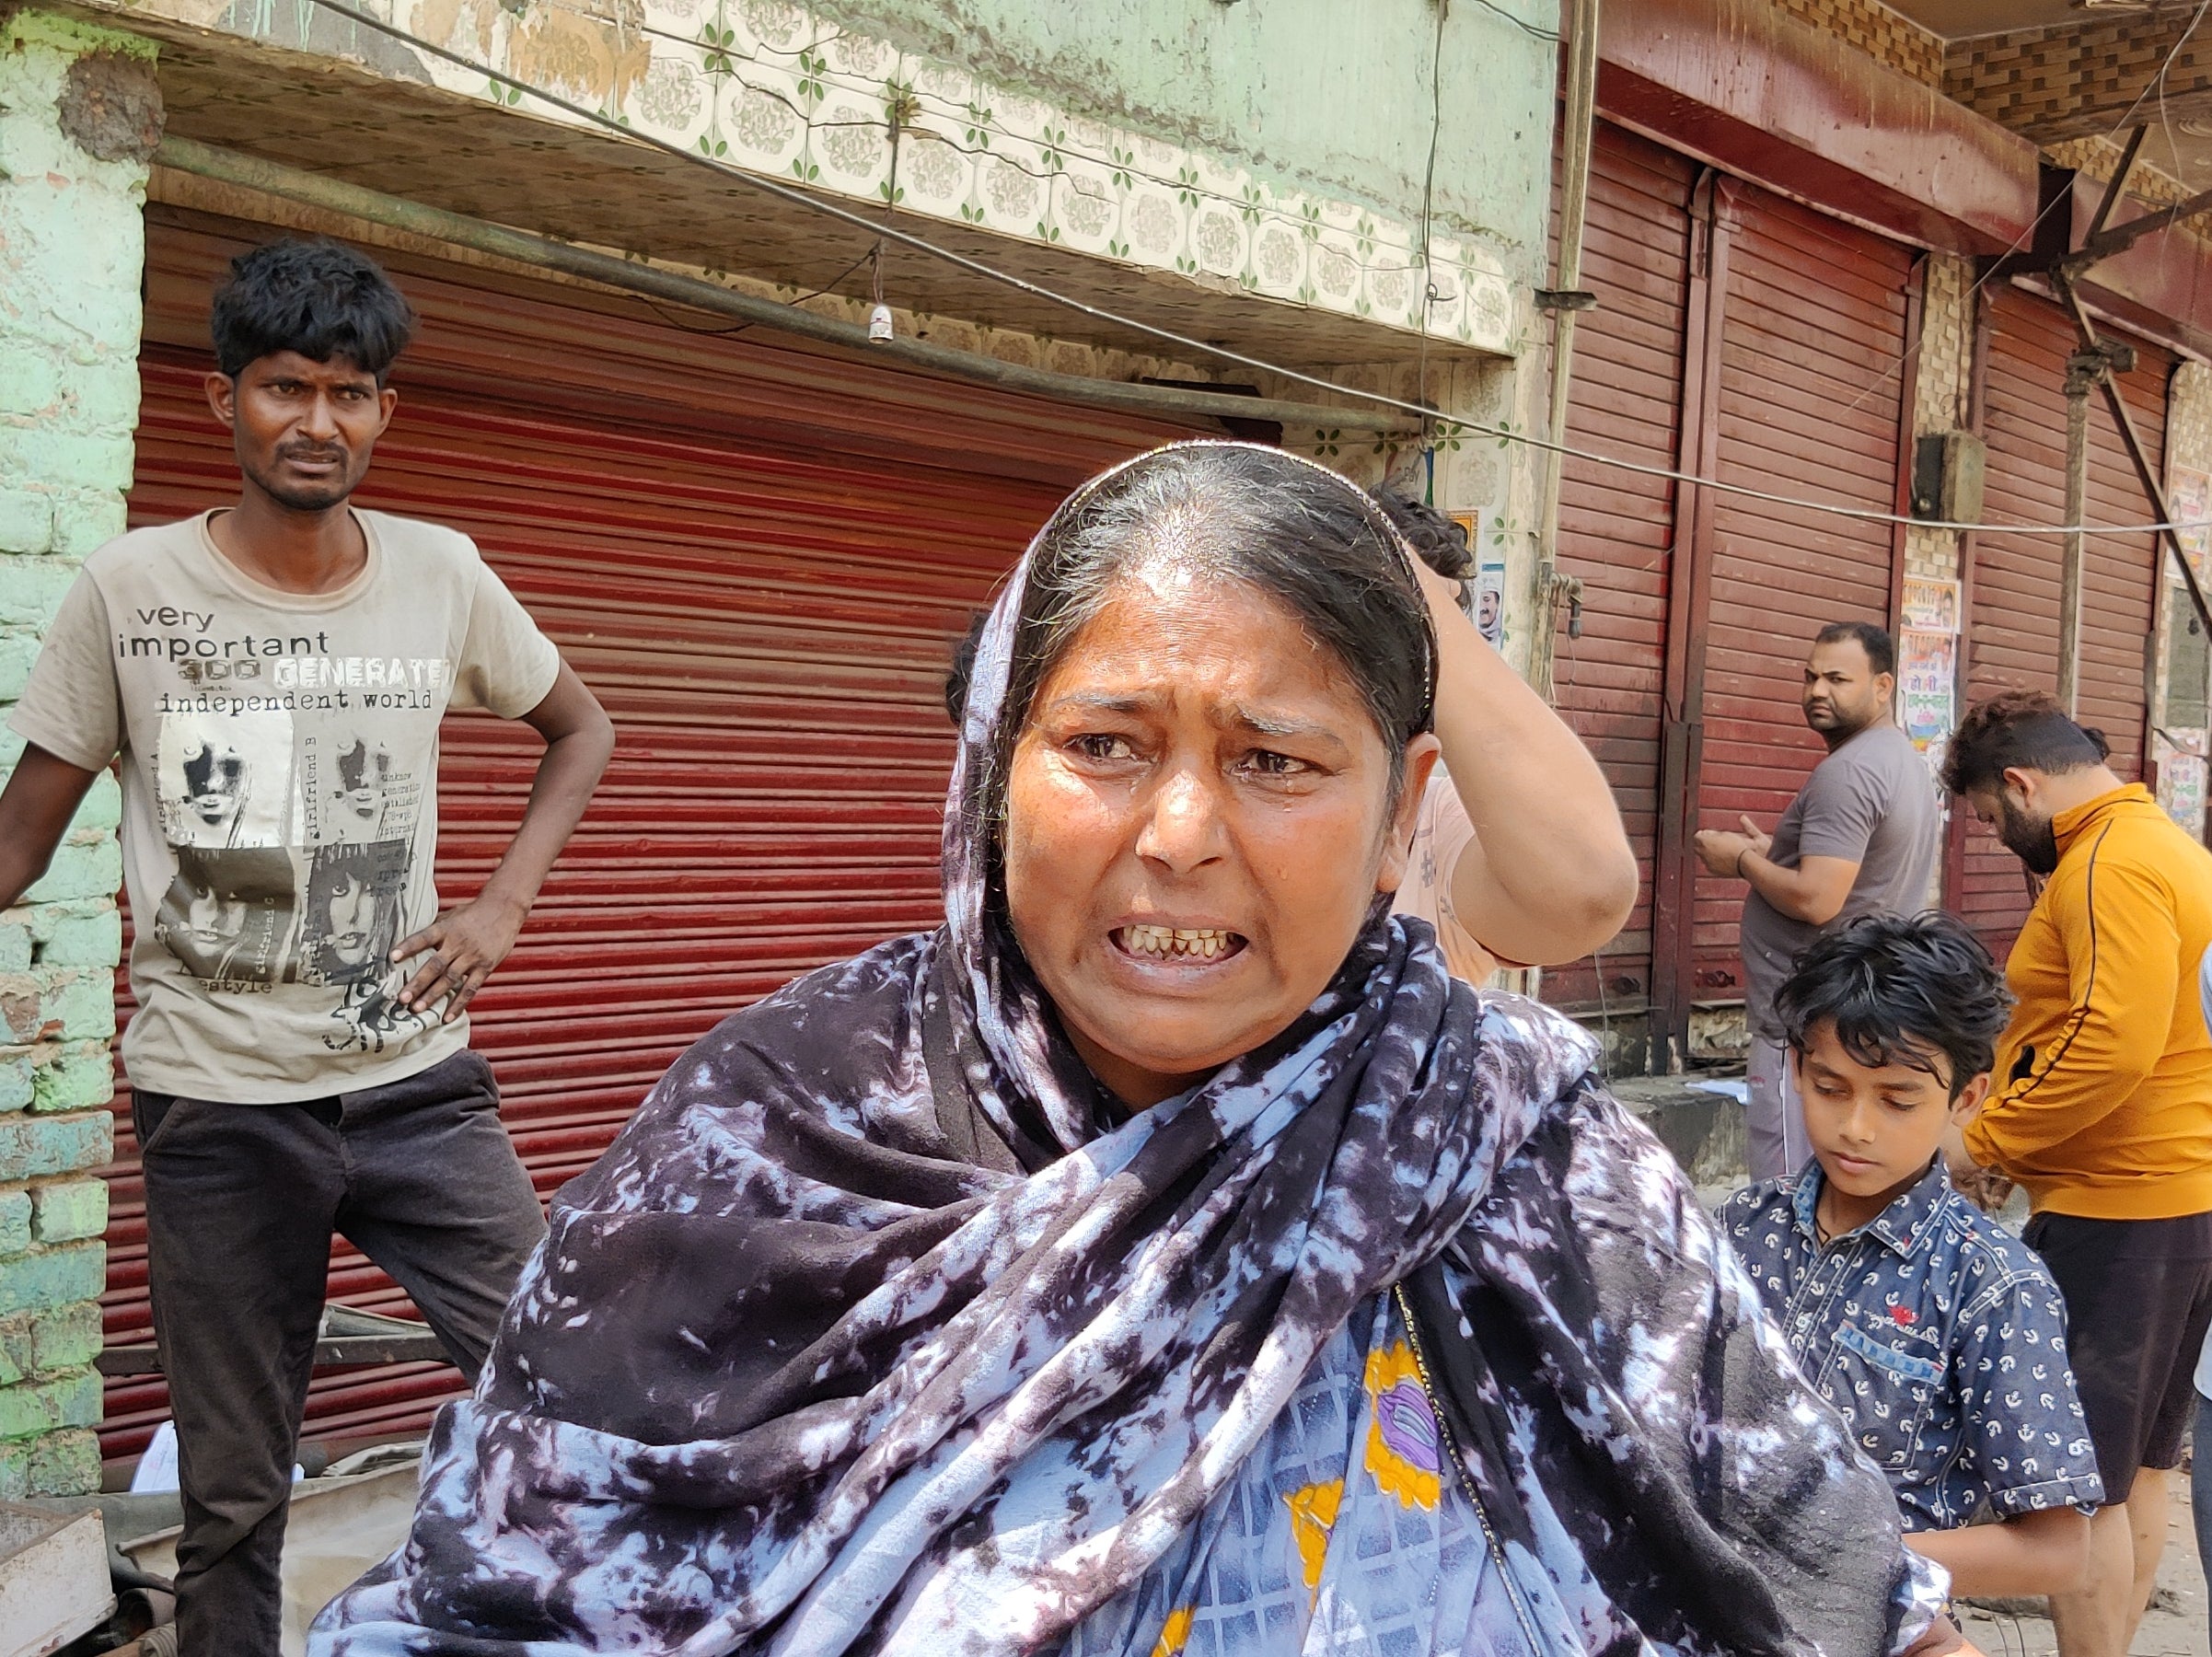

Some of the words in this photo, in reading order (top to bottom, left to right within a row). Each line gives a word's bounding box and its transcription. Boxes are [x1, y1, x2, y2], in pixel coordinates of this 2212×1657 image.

[136, 606, 214, 632] very
[119, 631, 330, 662] important
[159, 689, 349, 717] independent
[364, 689, 433, 709] world
[306, 737, 316, 747] B
[306, 754, 320, 840] girlfriend
